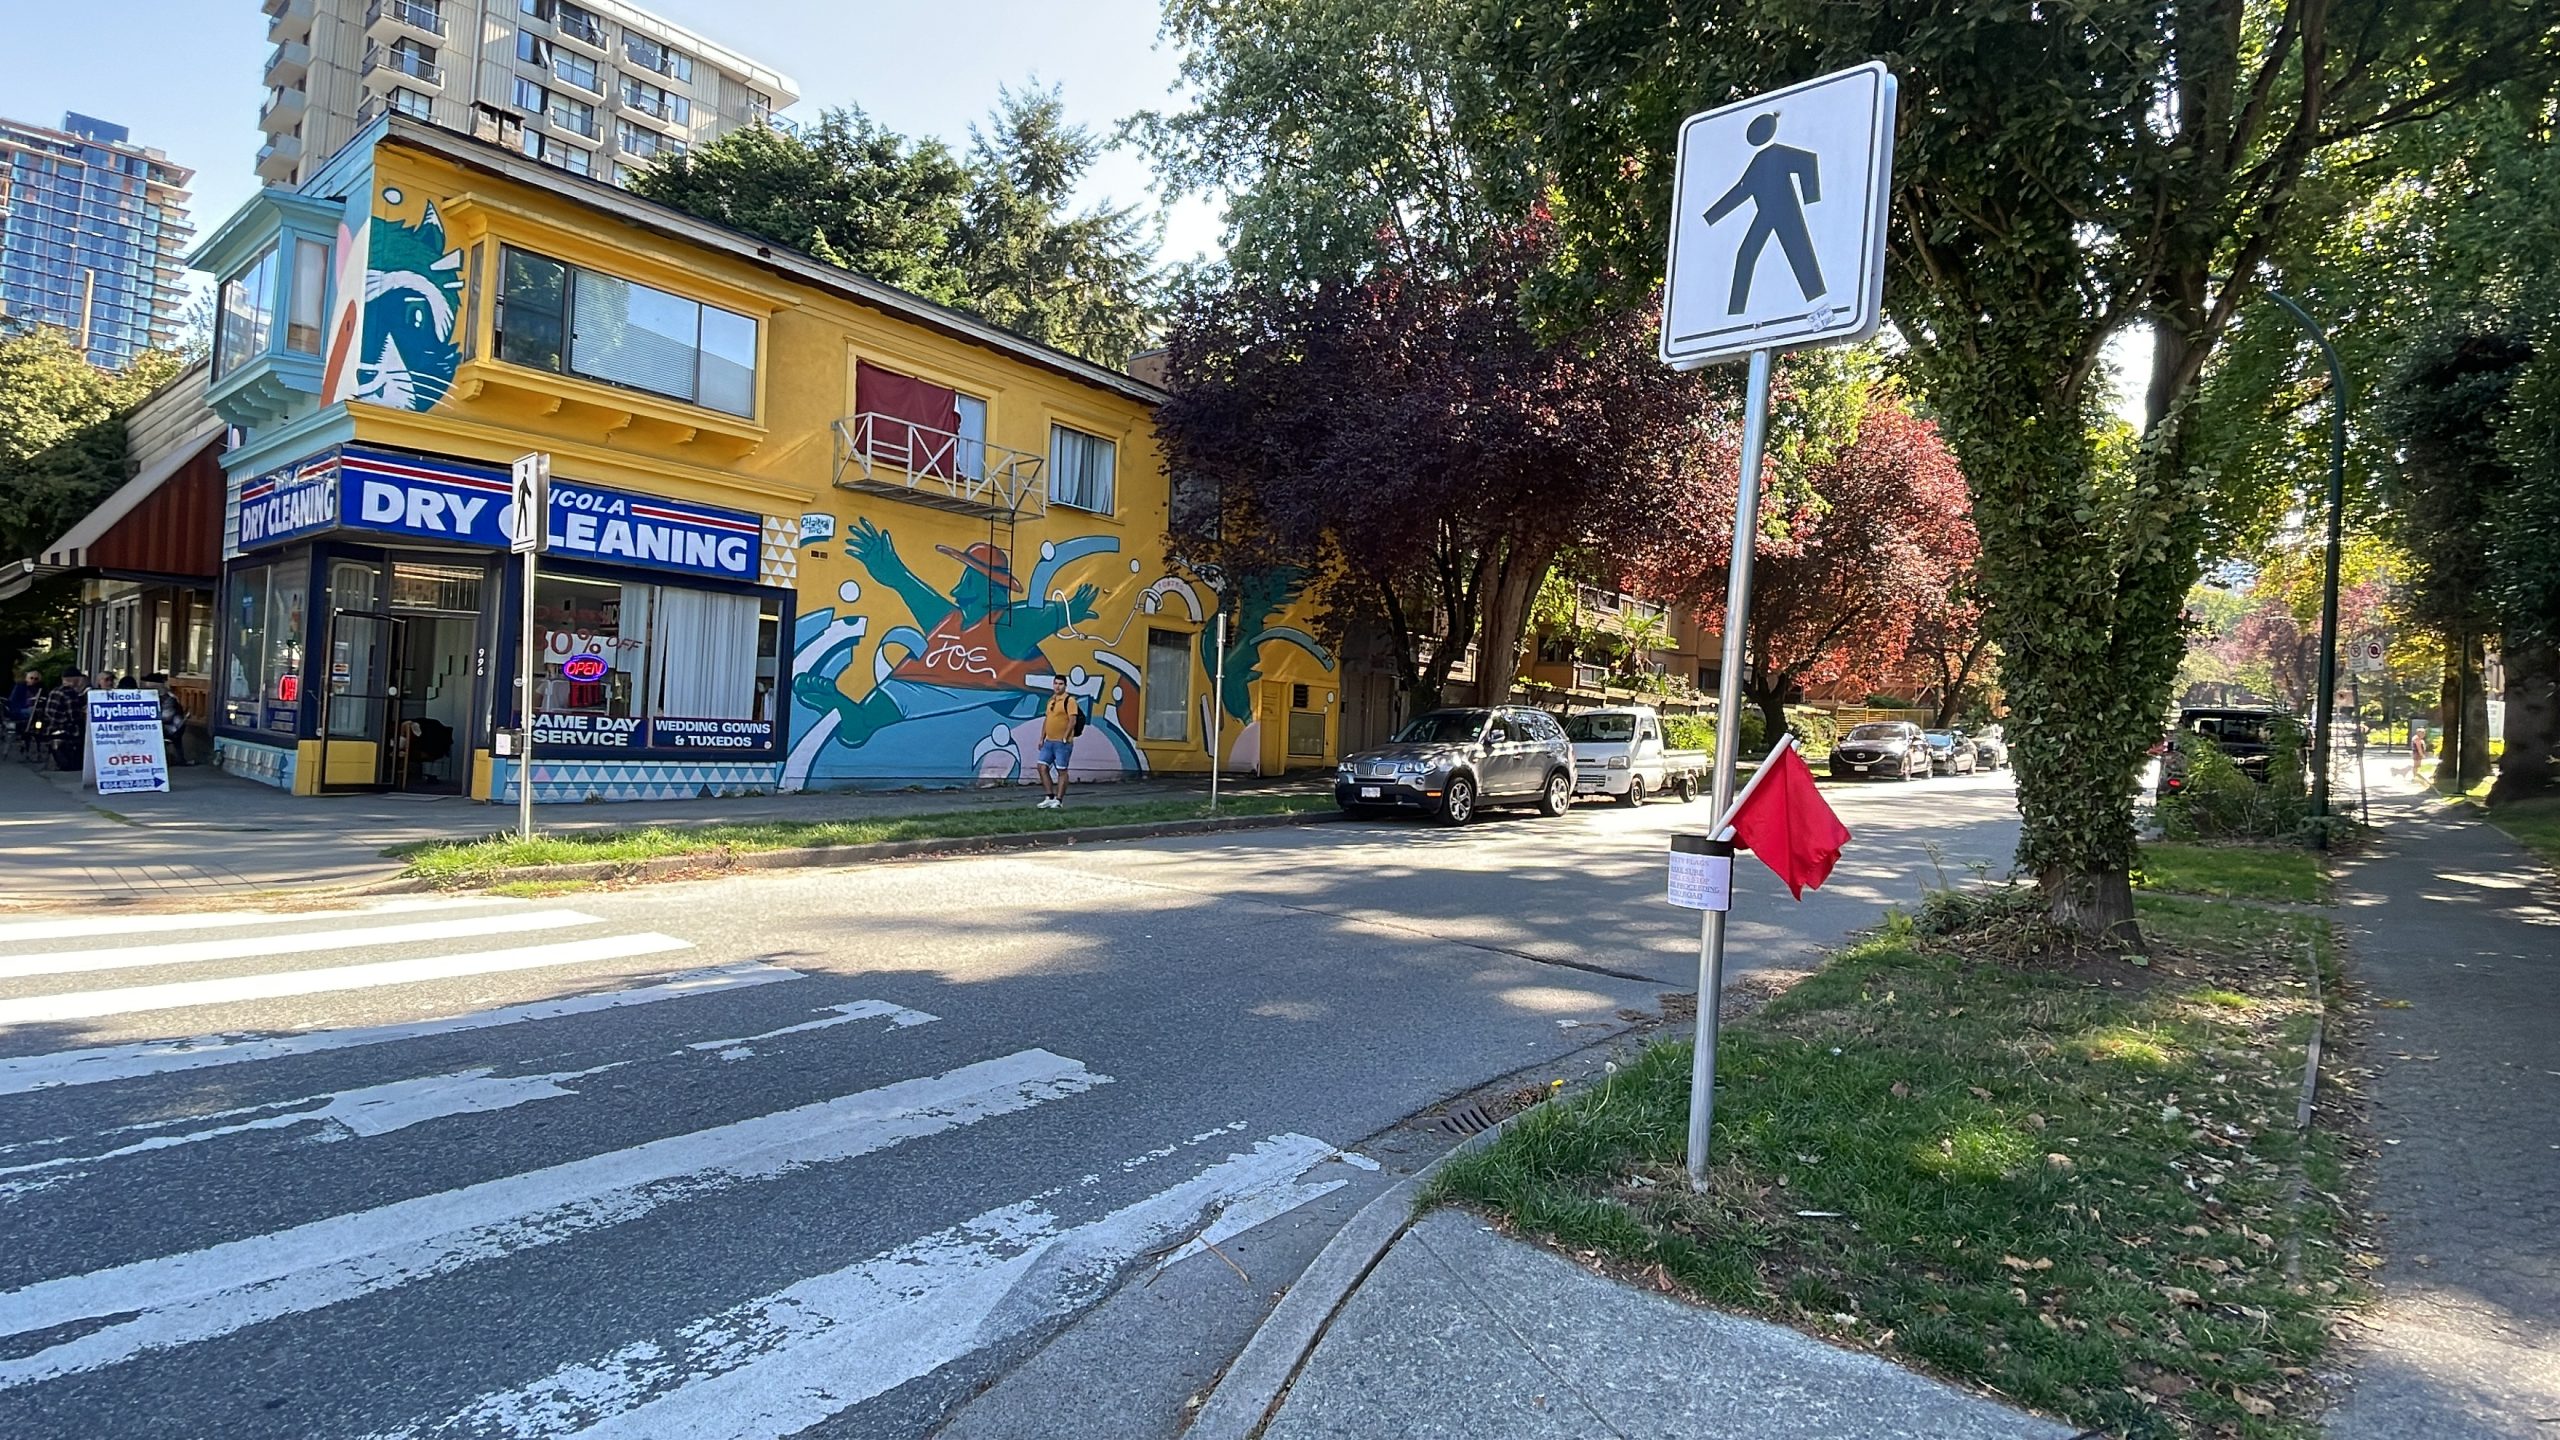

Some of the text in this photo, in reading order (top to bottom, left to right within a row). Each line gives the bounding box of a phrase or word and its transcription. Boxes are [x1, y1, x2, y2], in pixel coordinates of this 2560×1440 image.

[361, 480, 488, 535] DRY
[548, 488, 625, 516] ICOLA
[242, 502, 267, 542] DRY
[267, 479, 334, 536] CLEANING
[606, 636, 643, 651] OFF
[476, 648, 486, 677] 996
[566, 661, 603, 676] OPEN
[107, 691, 142, 701] Nicola
[93, 703, 157, 720] Drycleaning
[97, 723, 158, 732] Alterations
[596, 717, 641, 732] DAY
[656, 719, 771, 734] WEDDING GOWNS
[532, 729, 629, 746] SERVICE
[675, 735, 752, 747] & TUXEDOS
[108, 754, 154, 766] OPEN
